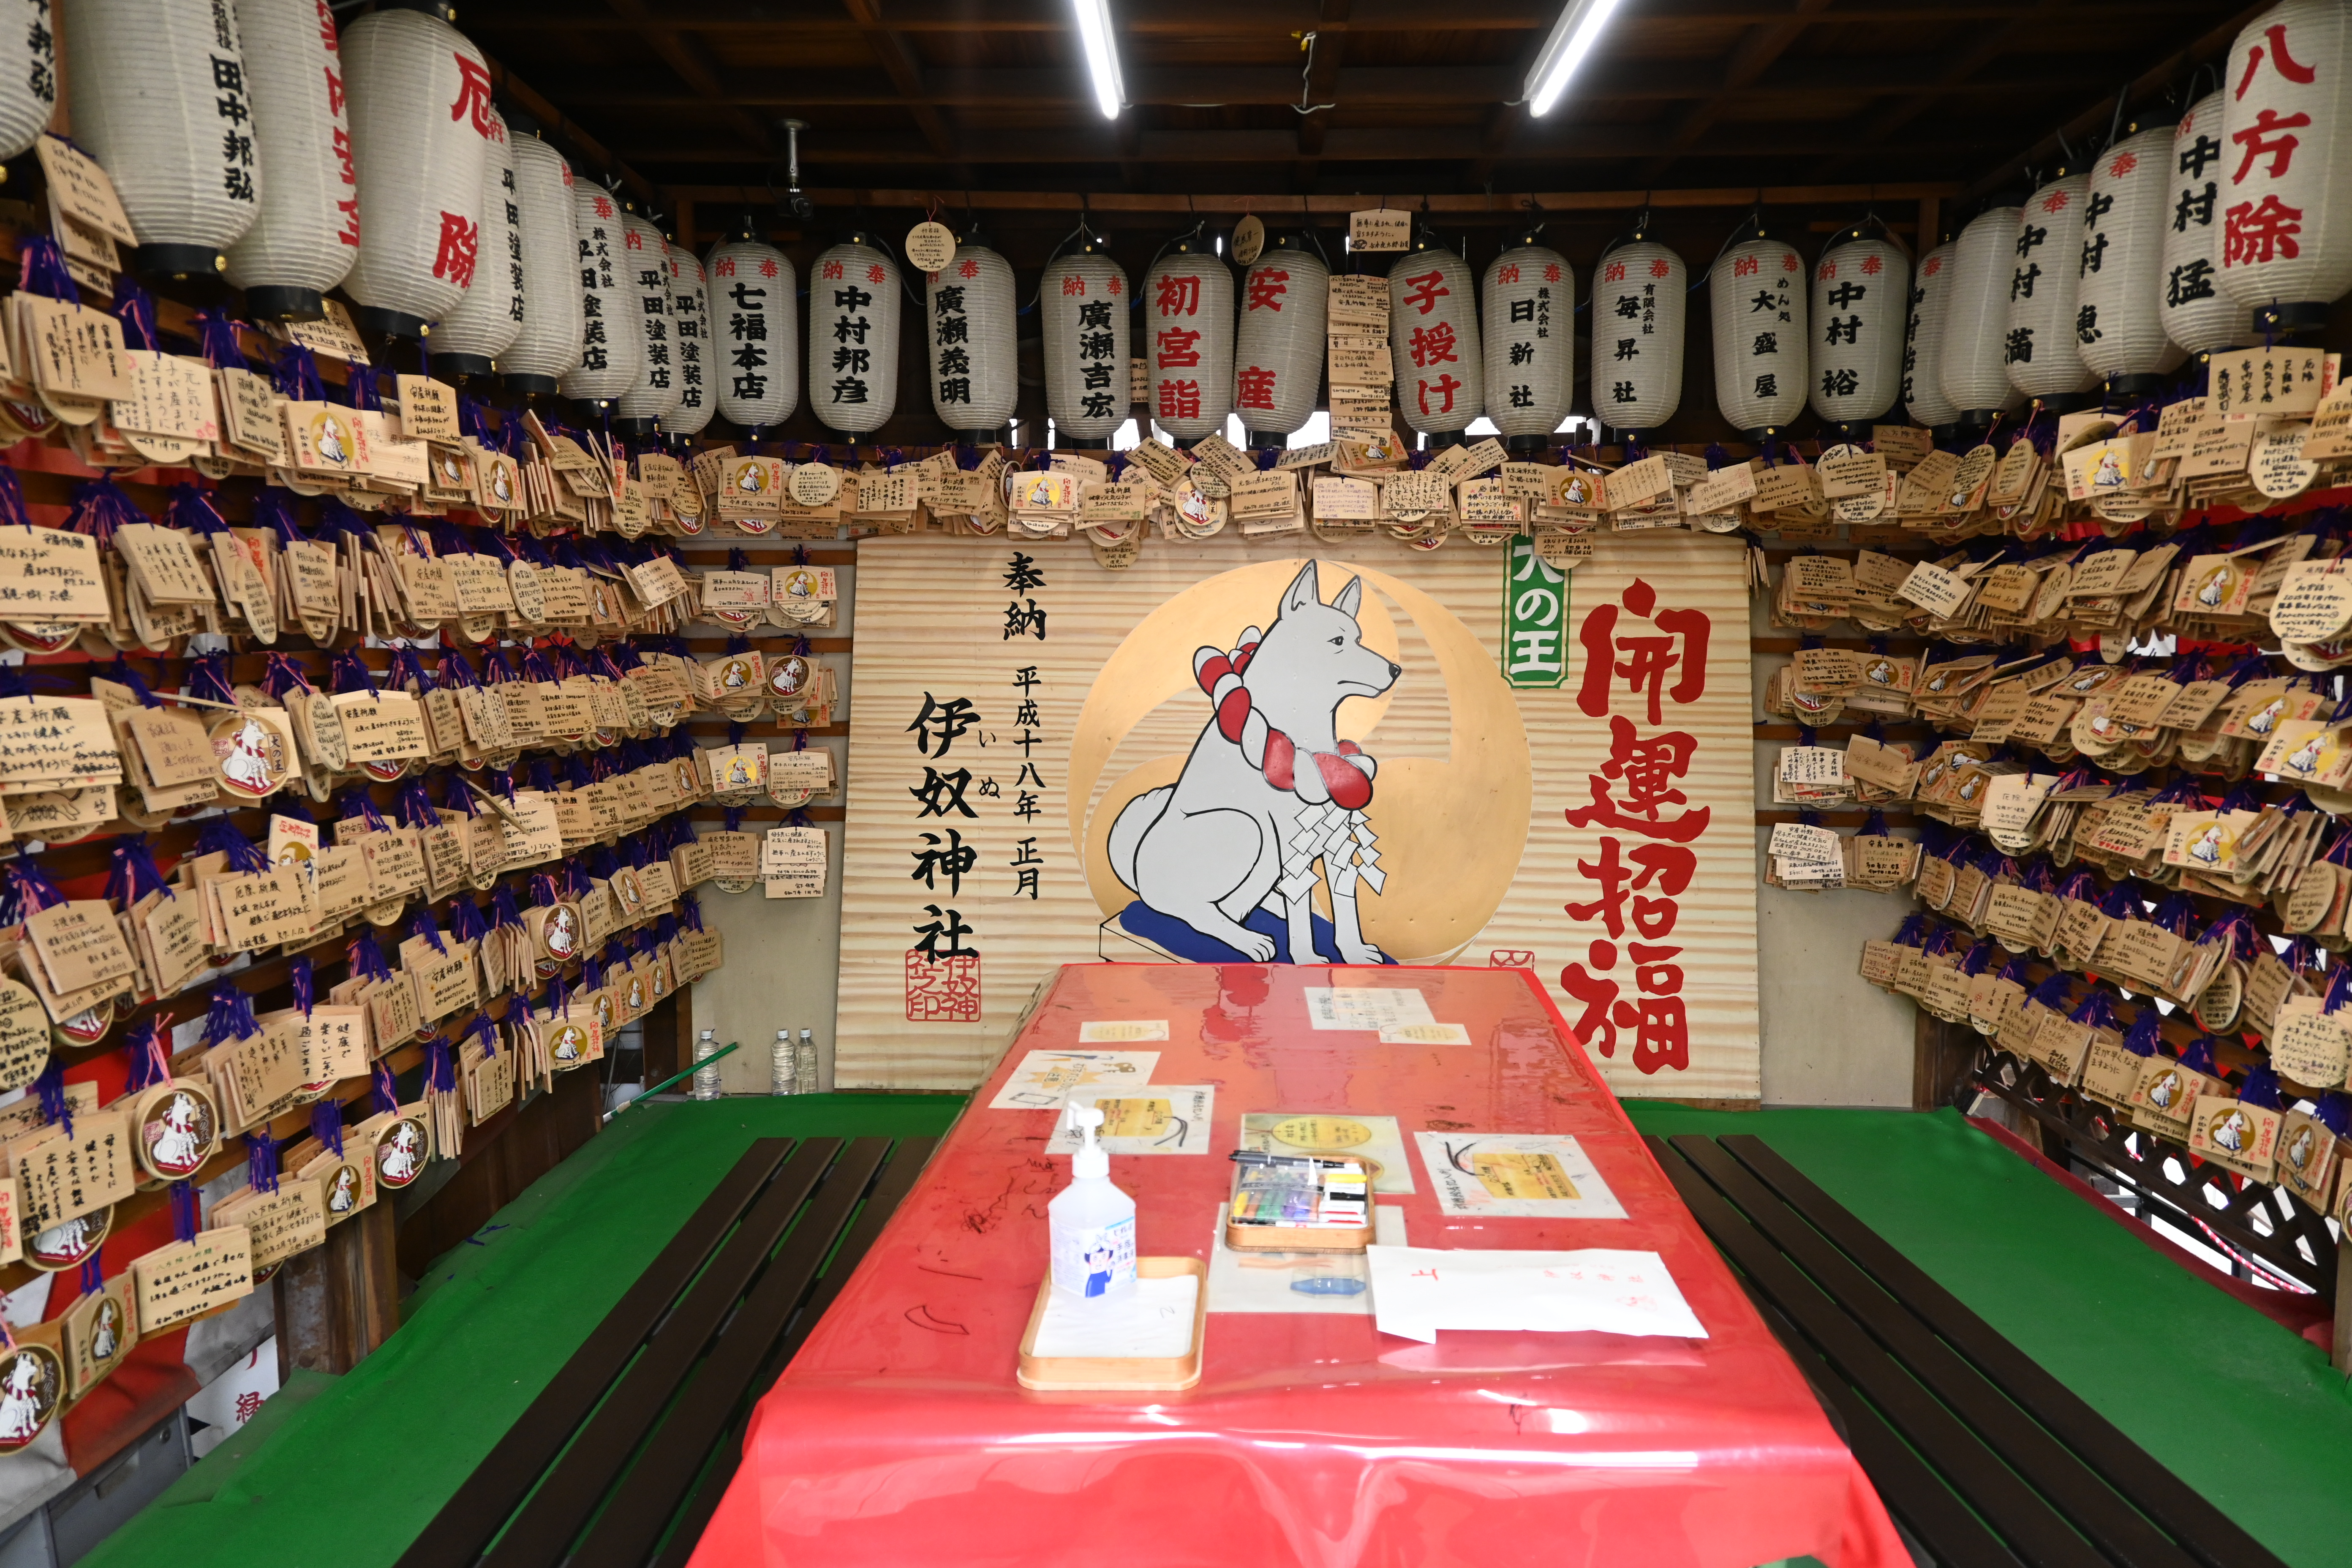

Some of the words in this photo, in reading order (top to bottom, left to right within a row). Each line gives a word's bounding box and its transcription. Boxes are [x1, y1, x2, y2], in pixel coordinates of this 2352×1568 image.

[2224, 24, 2317, 268] 八方除
[593, 196, 613, 220] 奉
[2166, 135, 2221, 309] 中村猛
[592, 226, 615, 288] 株式会社
[715, 258, 736, 278] 納
[758, 259, 779, 279] 奉
[822, 260, 843, 280] 納
[866, 264, 886, 285] 奉
[957, 259, 980, 280] 奉
[1063, 275, 1085, 297] 納
[1107, 275, 1123, 297] 奉
[1497, 264, 1519, 285] 納
[1542, 264, 1563, 284] 奉
[1605, 261, 1625, 283] 納
[1649, 259, 1670, 279] 奉
[1734, 256, 1759, 278] 納
[1781, 254, 1799, 273] 奉
[1860, 256, 1883, 276] 奉
[1537, 287, 1550, 338] 株式会社
[1642, 283, 1656, 335] 有限会社
[1777, 278, 1792, 322] めん処
[2005, 224, 2047, 367] 中村満
[637, 270, 671, 389] 平田塗装店
[675, 295, 703, 408] 平田塗装店
[728, 282, 768, 400] 七福本店
[831, 286, 872, 404] 中村邦彦
[1156, 275, 1202, 419] 初宮詣
[1236, 266, 1290, 410] 安産
[1403, 270, 1462, 416] 子授け
[1508, 299, 1535, 408] 日新社
[1750, 290, 1779, 398] 大盛屋
[1821, 282, 1866, 397] 中村裕
[1003, 552, 1047, 641] 奉納
[1012, 666, 1047, 824] 平成十八年
[905, 691, 982, 964] 伊奴神社
[1561, 577, 1711, 1074] 開運招福
[1010, 837, 1044, 900] 正月
